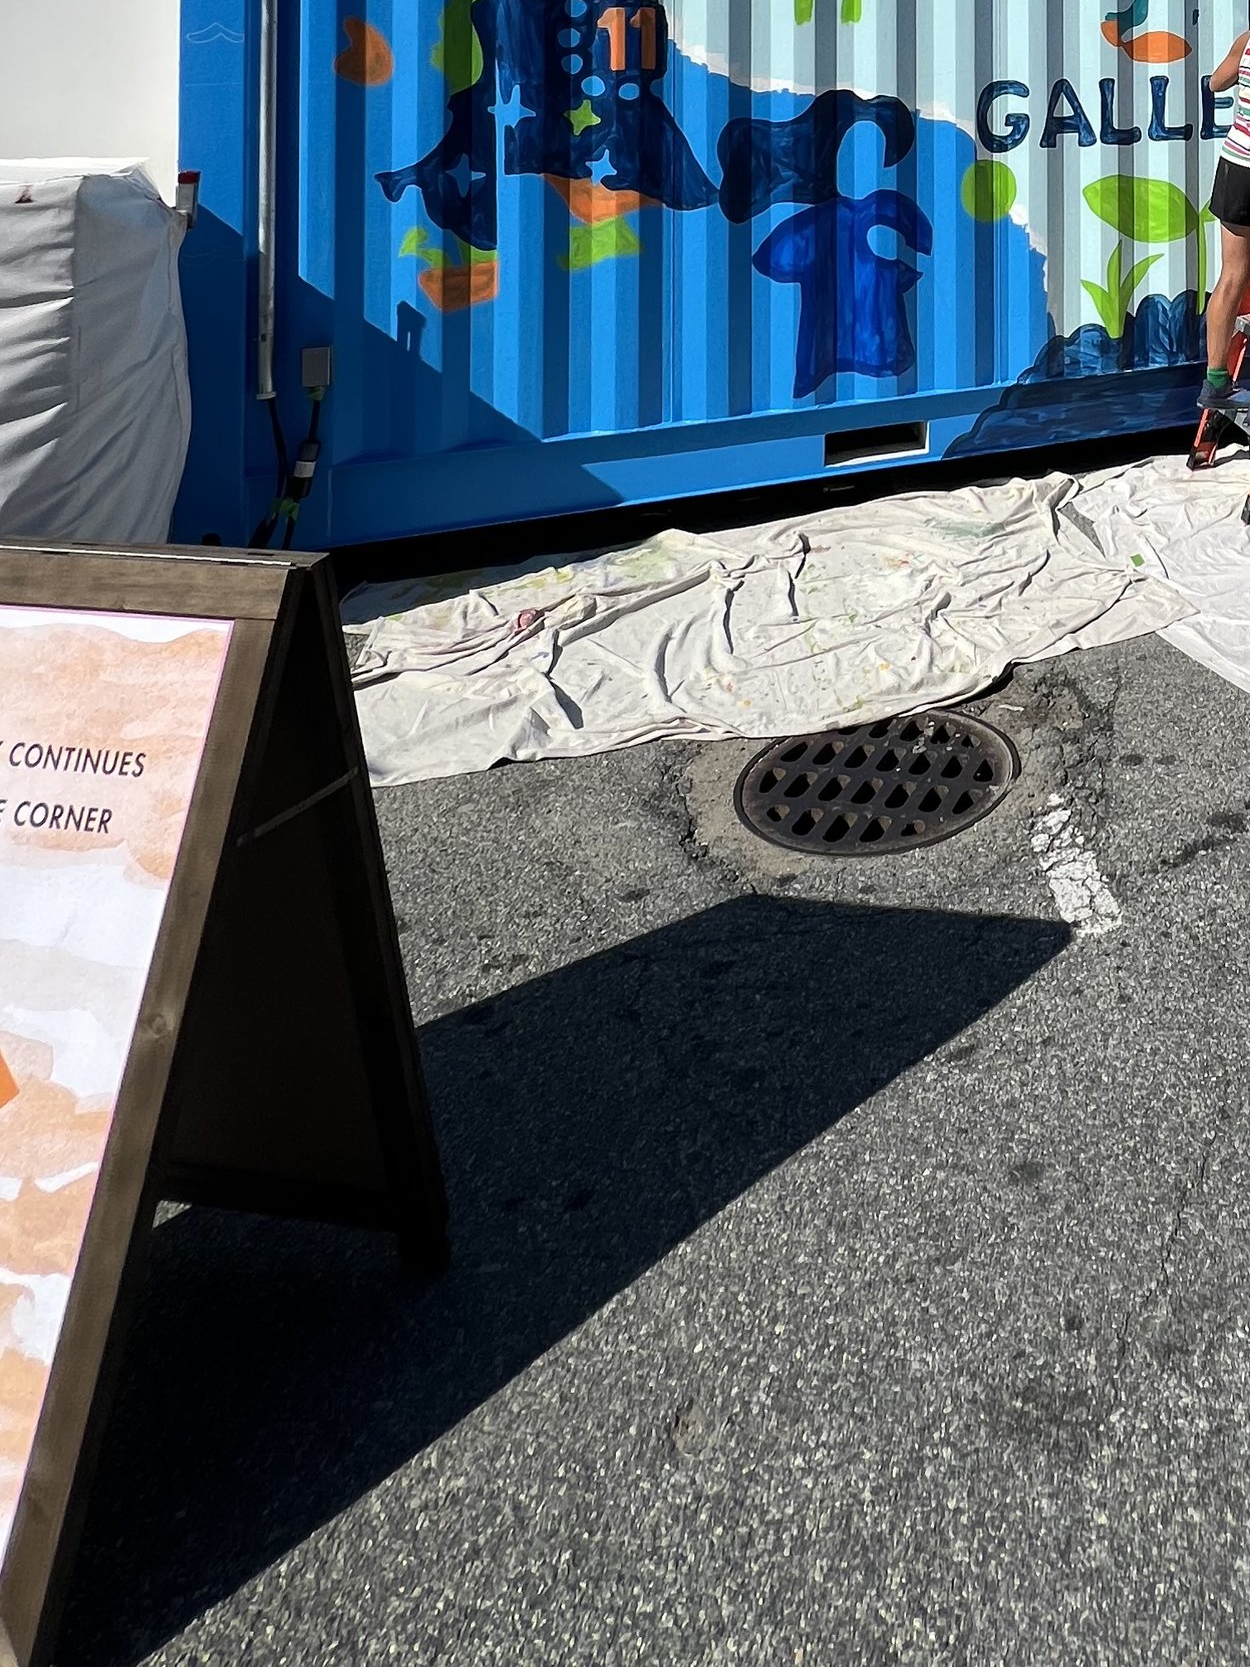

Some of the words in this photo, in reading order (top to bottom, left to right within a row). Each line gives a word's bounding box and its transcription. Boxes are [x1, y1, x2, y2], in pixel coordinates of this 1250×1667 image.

[597, 7, 656, 71] 11
[9, 742, 147, 777] CONTINUES
[14, 801, 113, 834] CORNER
